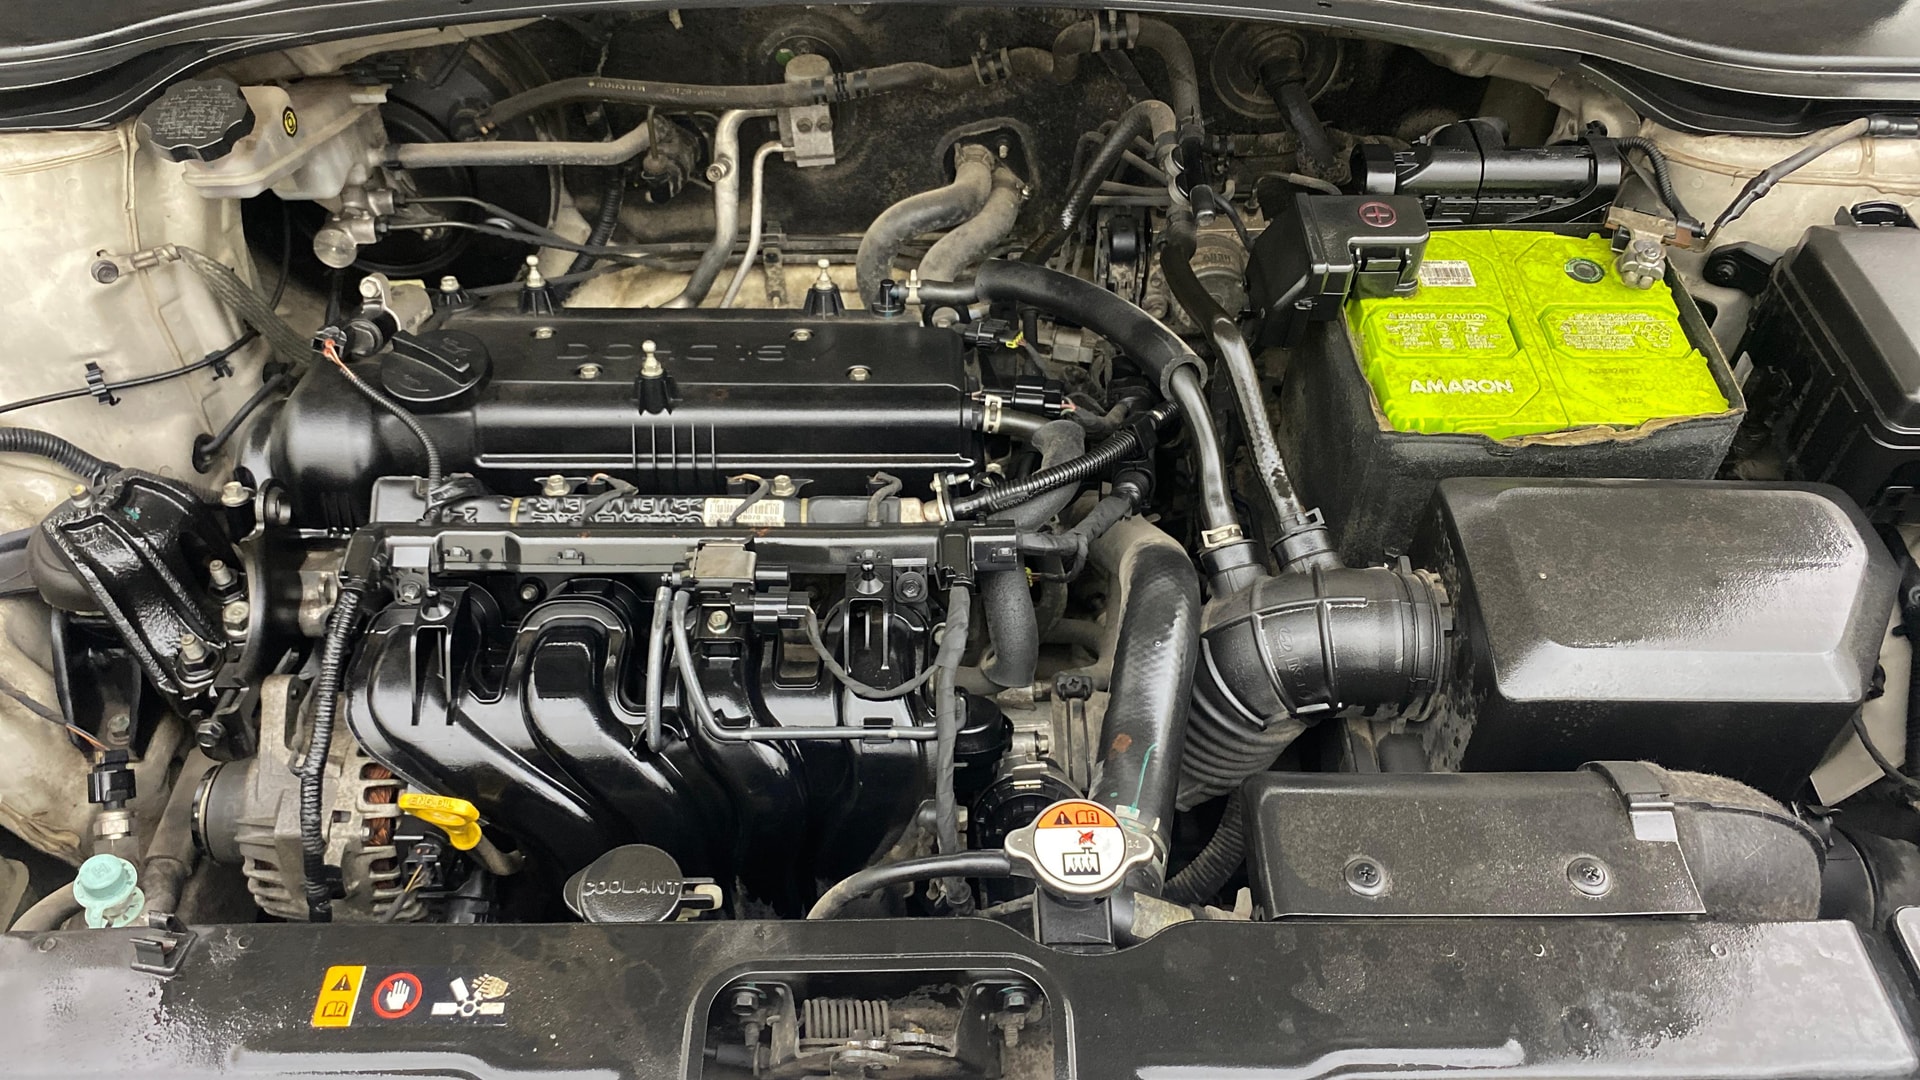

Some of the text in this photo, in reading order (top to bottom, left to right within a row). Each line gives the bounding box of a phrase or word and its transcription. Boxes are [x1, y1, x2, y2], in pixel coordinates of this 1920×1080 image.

[1398, 312, 1437, 320] DANGER
[1446, 312, 1488, 320] CAUTION
[1410, 379, 1514, 395] AMARON
[583, 880, 680, 897] COOLANT
